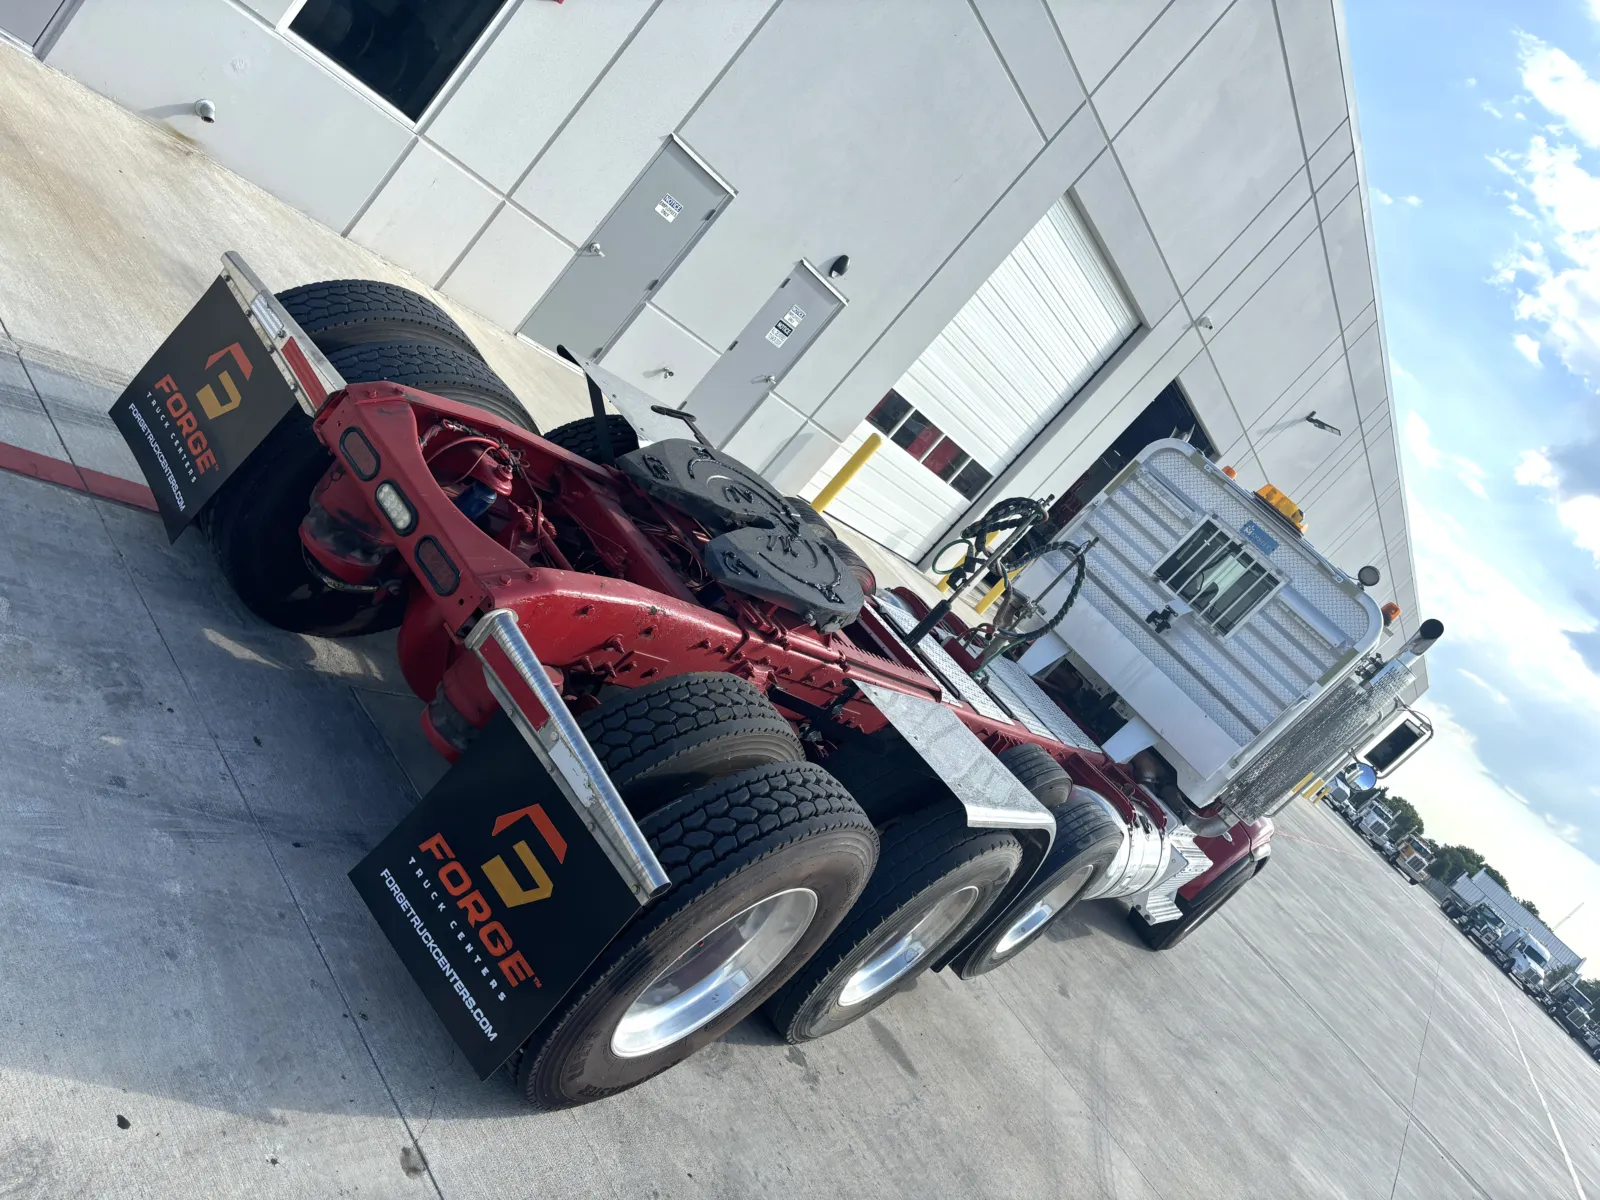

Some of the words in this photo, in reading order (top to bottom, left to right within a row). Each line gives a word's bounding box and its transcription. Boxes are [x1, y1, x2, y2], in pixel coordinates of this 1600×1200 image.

[659, 200, 678, 218] EMPLOYEES
[664, 195, 683, 213] NOTICE
[776, 321, 792, 336] NOTICE
[128, 402, 186, 512] FORGETRUCKCENTERS.COM
[146, 391, 170, 429] TRUCK
[170, 432, 197, 484] CENTERS
[154, 374, 216, 475] FORGE
[380, 868, 498, 1042] FORGETRUCKCENTERS.COM
[408, 856, 446, 912] TRUCK
[449, 920, 507, 1002] CENTERS
[419, 833, 534, 988] FORGE
